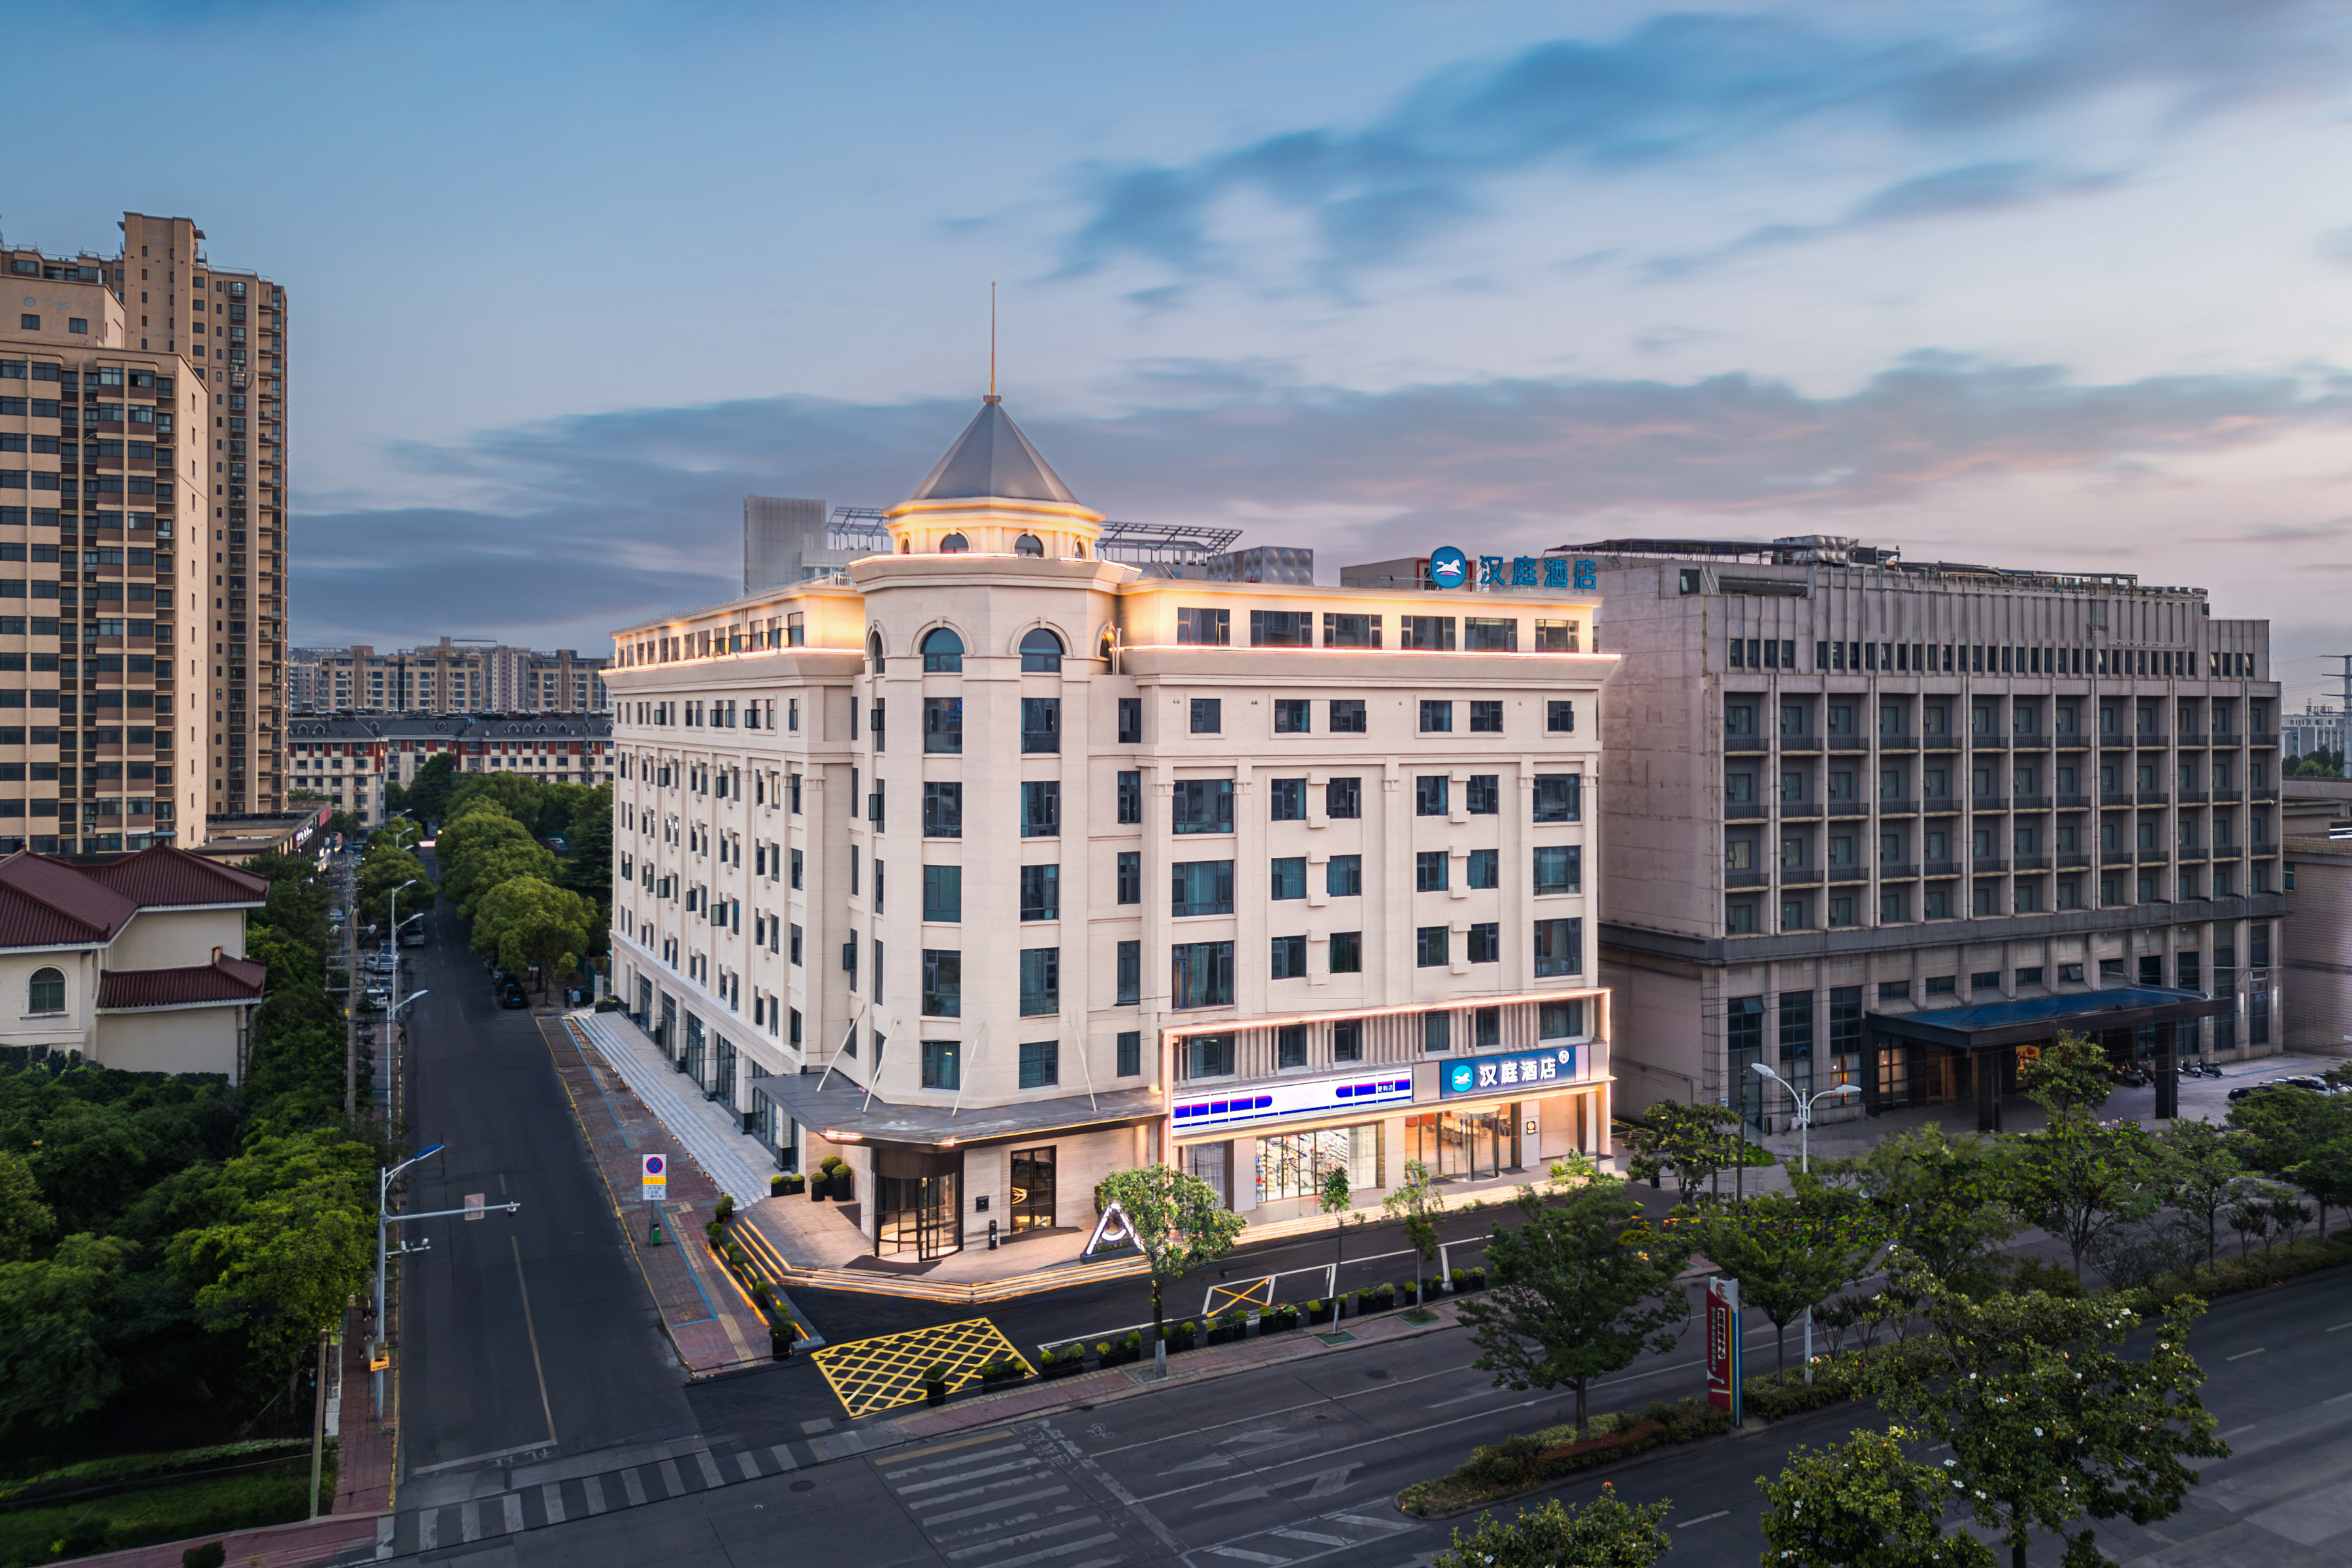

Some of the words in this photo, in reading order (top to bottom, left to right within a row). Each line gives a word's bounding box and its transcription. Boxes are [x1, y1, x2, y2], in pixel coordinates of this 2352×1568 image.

[1480, 555, 1596, 589] 汉庭酒店
[1479, 1058, 1556, 1087] 汉庭酒店
